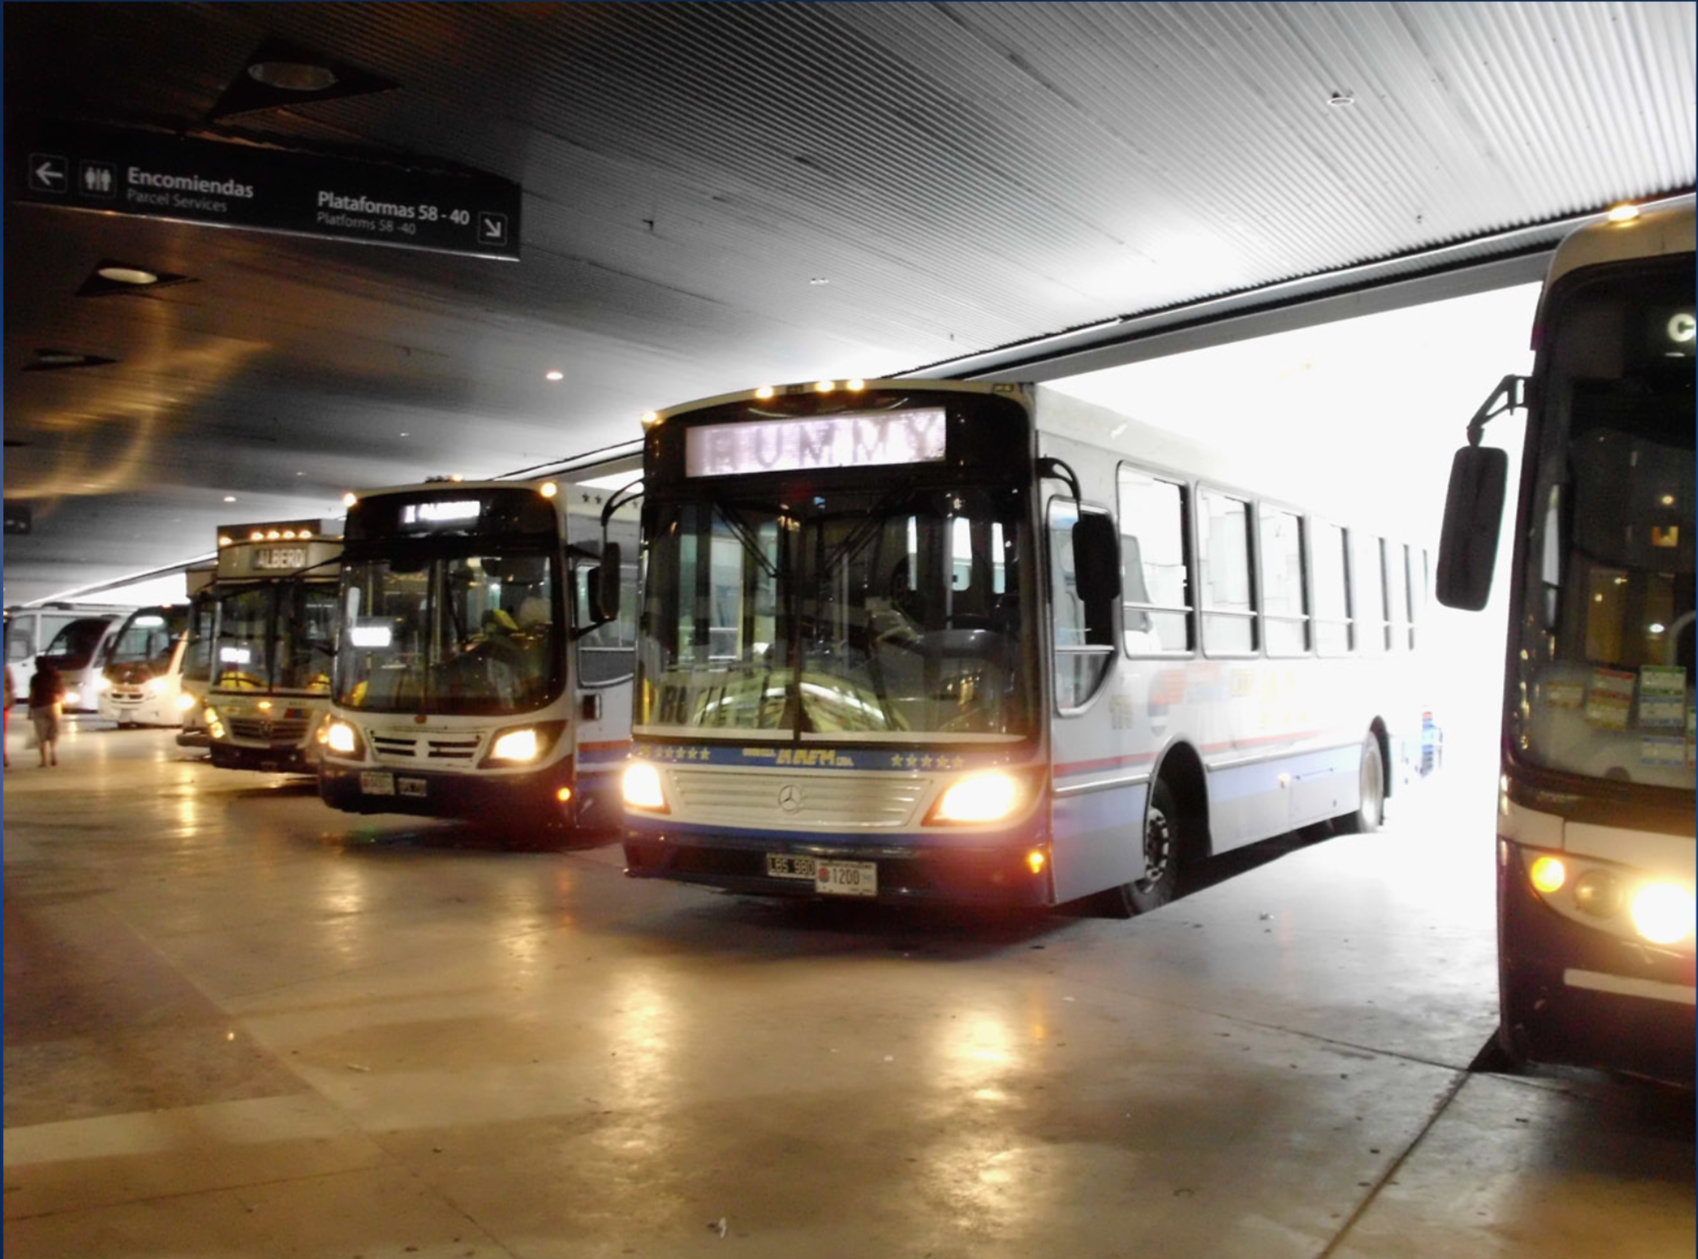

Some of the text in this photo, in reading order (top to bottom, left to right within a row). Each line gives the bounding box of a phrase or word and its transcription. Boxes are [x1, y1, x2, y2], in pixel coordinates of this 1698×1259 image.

[128, 166, 254, 198] Encomiendas
[127, 188, 228, 213] Parcel Services
[318, 190, 415, 218] Plataformas
[418, 205, 438, 221] 58
[450, 209, 470, 225] 40
[317, 211, 376, 230] Platforms
[379, 219, 394, 232] 58
